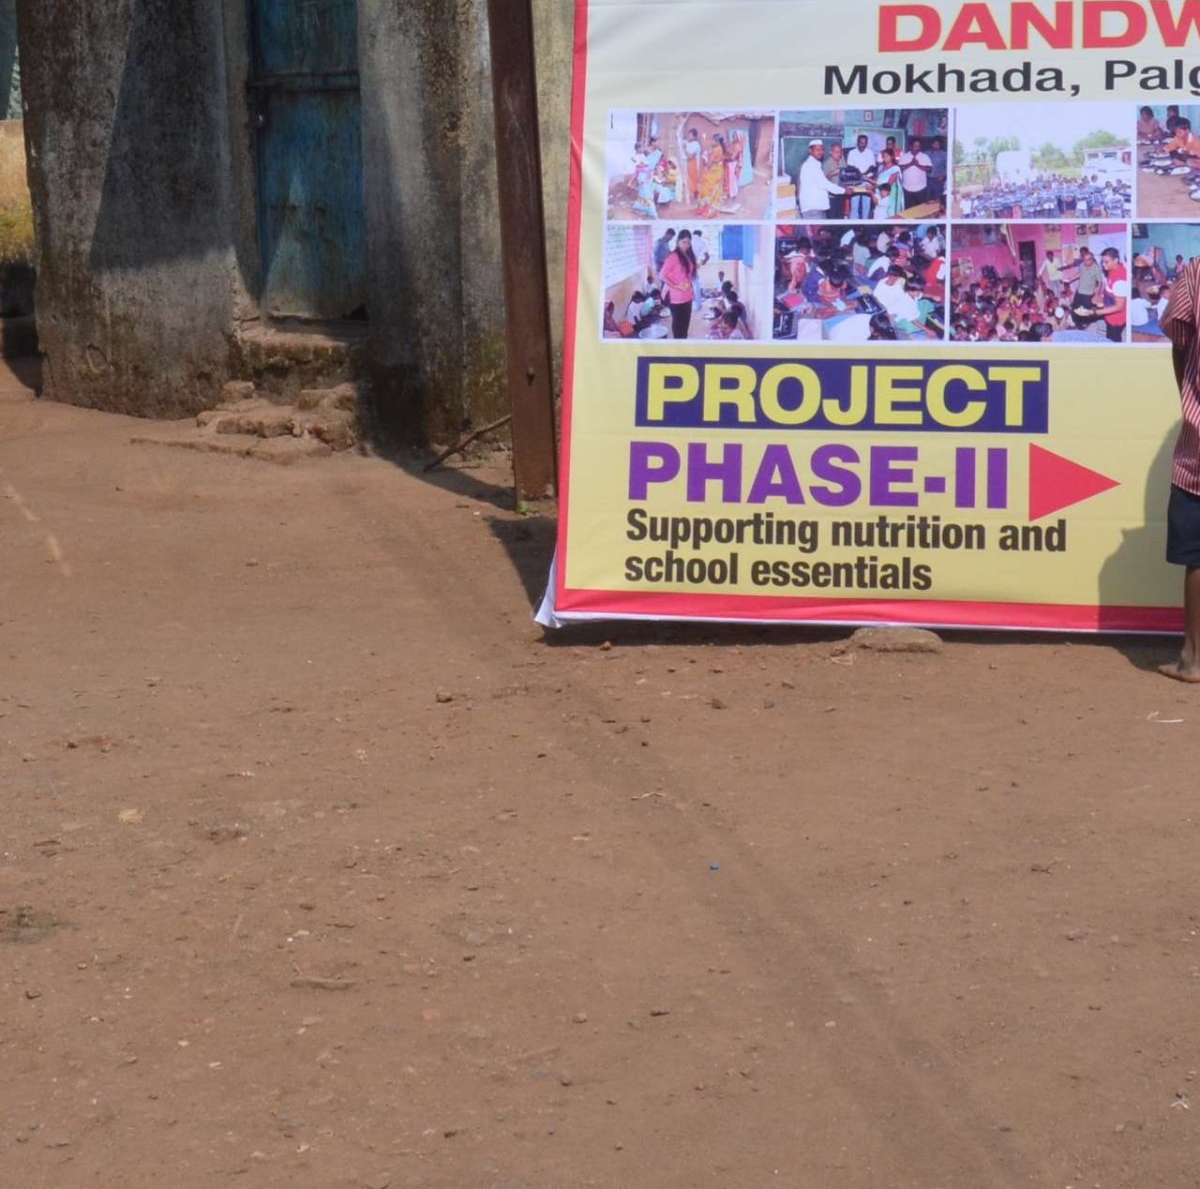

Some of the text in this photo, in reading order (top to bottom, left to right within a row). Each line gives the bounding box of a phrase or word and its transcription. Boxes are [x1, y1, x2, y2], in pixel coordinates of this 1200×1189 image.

[823, 60, 1081, 98] Mokhada,
[647, 364, 1043, 427] PROJECT
[628, 441, 1009, 510] PHASE-II
[626, 508, 1067, 554] Supporting nutrition and
[624, 552, 933, 591] school essentials
